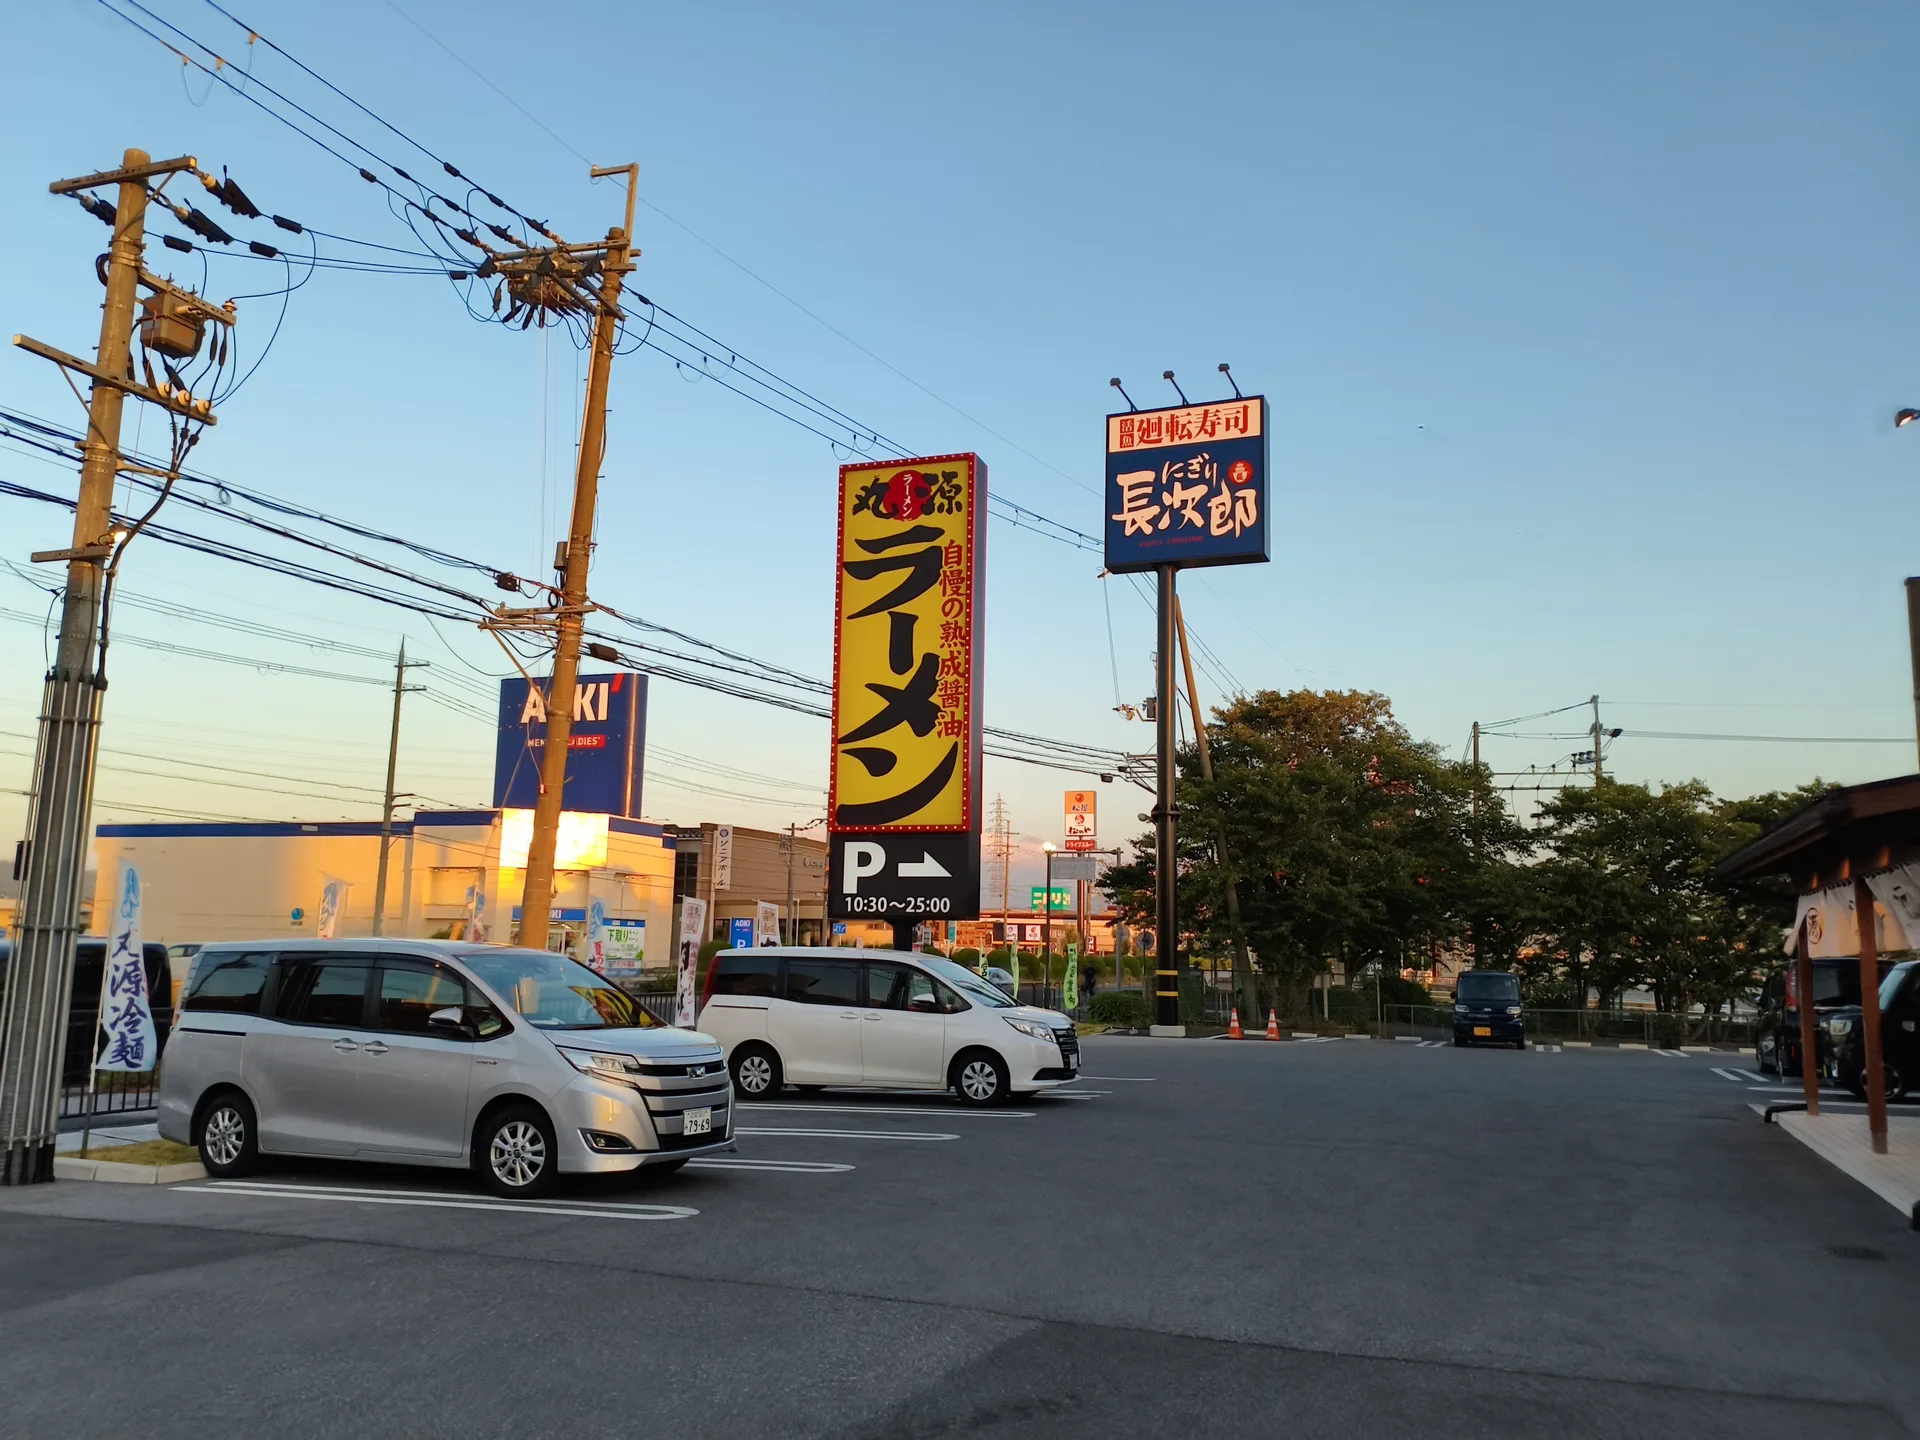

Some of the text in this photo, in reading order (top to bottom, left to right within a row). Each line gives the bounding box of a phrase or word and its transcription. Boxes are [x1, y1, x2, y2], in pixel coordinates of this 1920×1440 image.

[1136, 404, 1250, 446] 廻転寿司
[1161, 453, 1218, 488] にぎり
[902, 473, 913, 517] ラーメン
[1112, 470, 1258, 538] 長次郎
[937, 539, 967, 739] 自慢の熟成醤油
[836, 525, 958, 826] ラーメン
[521, 683, 609, 723] AKI
[842, 841, 886, 894] P
[607, 929, 629, 942] 下取り
[689, 1118, 710, 1133] 79-69
